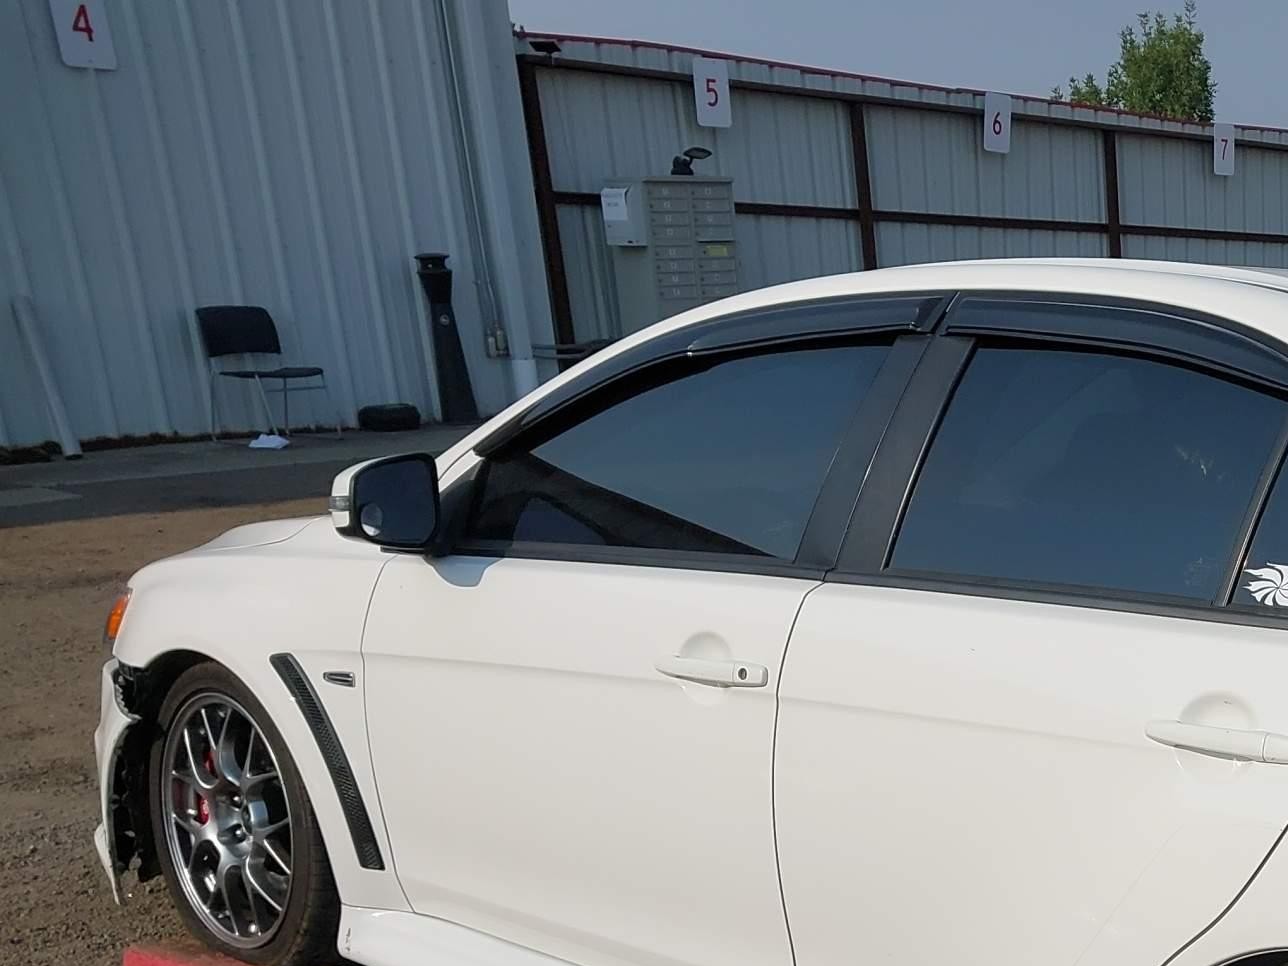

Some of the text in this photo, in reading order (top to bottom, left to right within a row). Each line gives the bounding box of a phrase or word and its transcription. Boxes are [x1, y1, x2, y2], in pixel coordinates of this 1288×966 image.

[72, 4, 94, 42] 4
[706, 78, 719, 107] 5
[992, 111, 1002, 136] 6
[1221, 138, 1228, 161] 7
